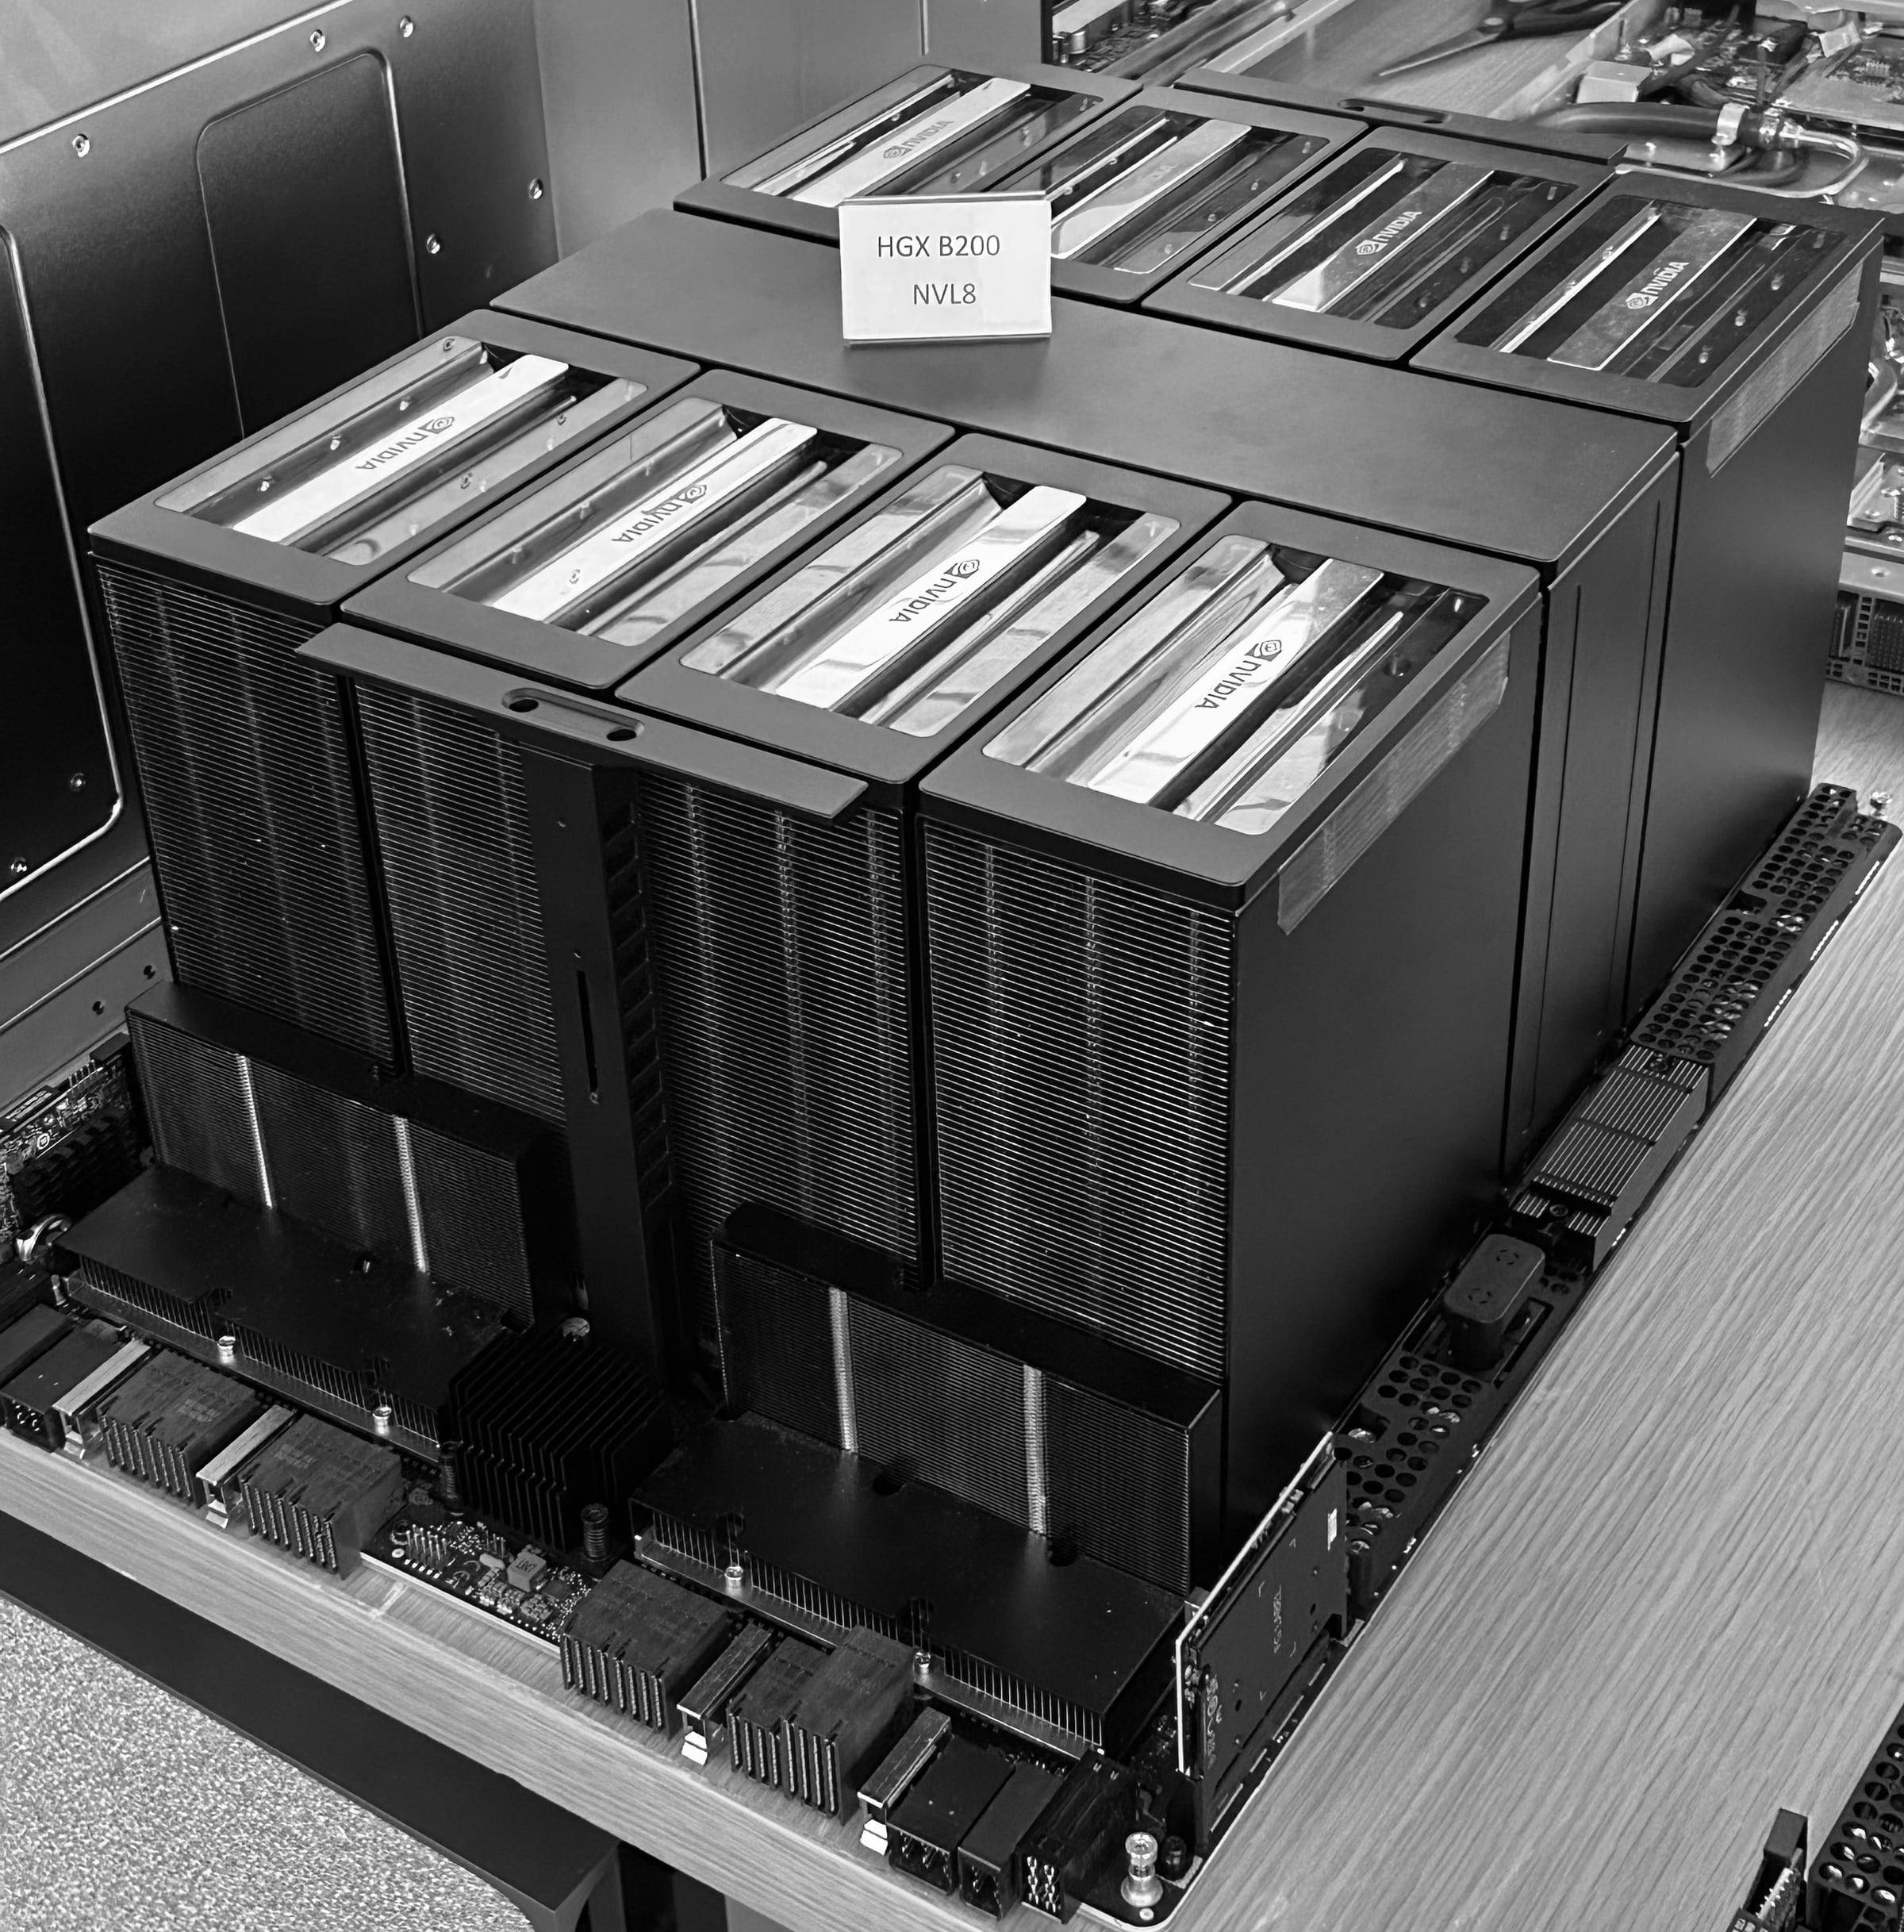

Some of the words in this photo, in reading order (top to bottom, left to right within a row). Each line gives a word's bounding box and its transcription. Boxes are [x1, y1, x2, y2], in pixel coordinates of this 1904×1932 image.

[878, 236, 930, 257] HGX
[939, 235, 1000, 256] B200
[914, 283, 976, 305] NVL8
